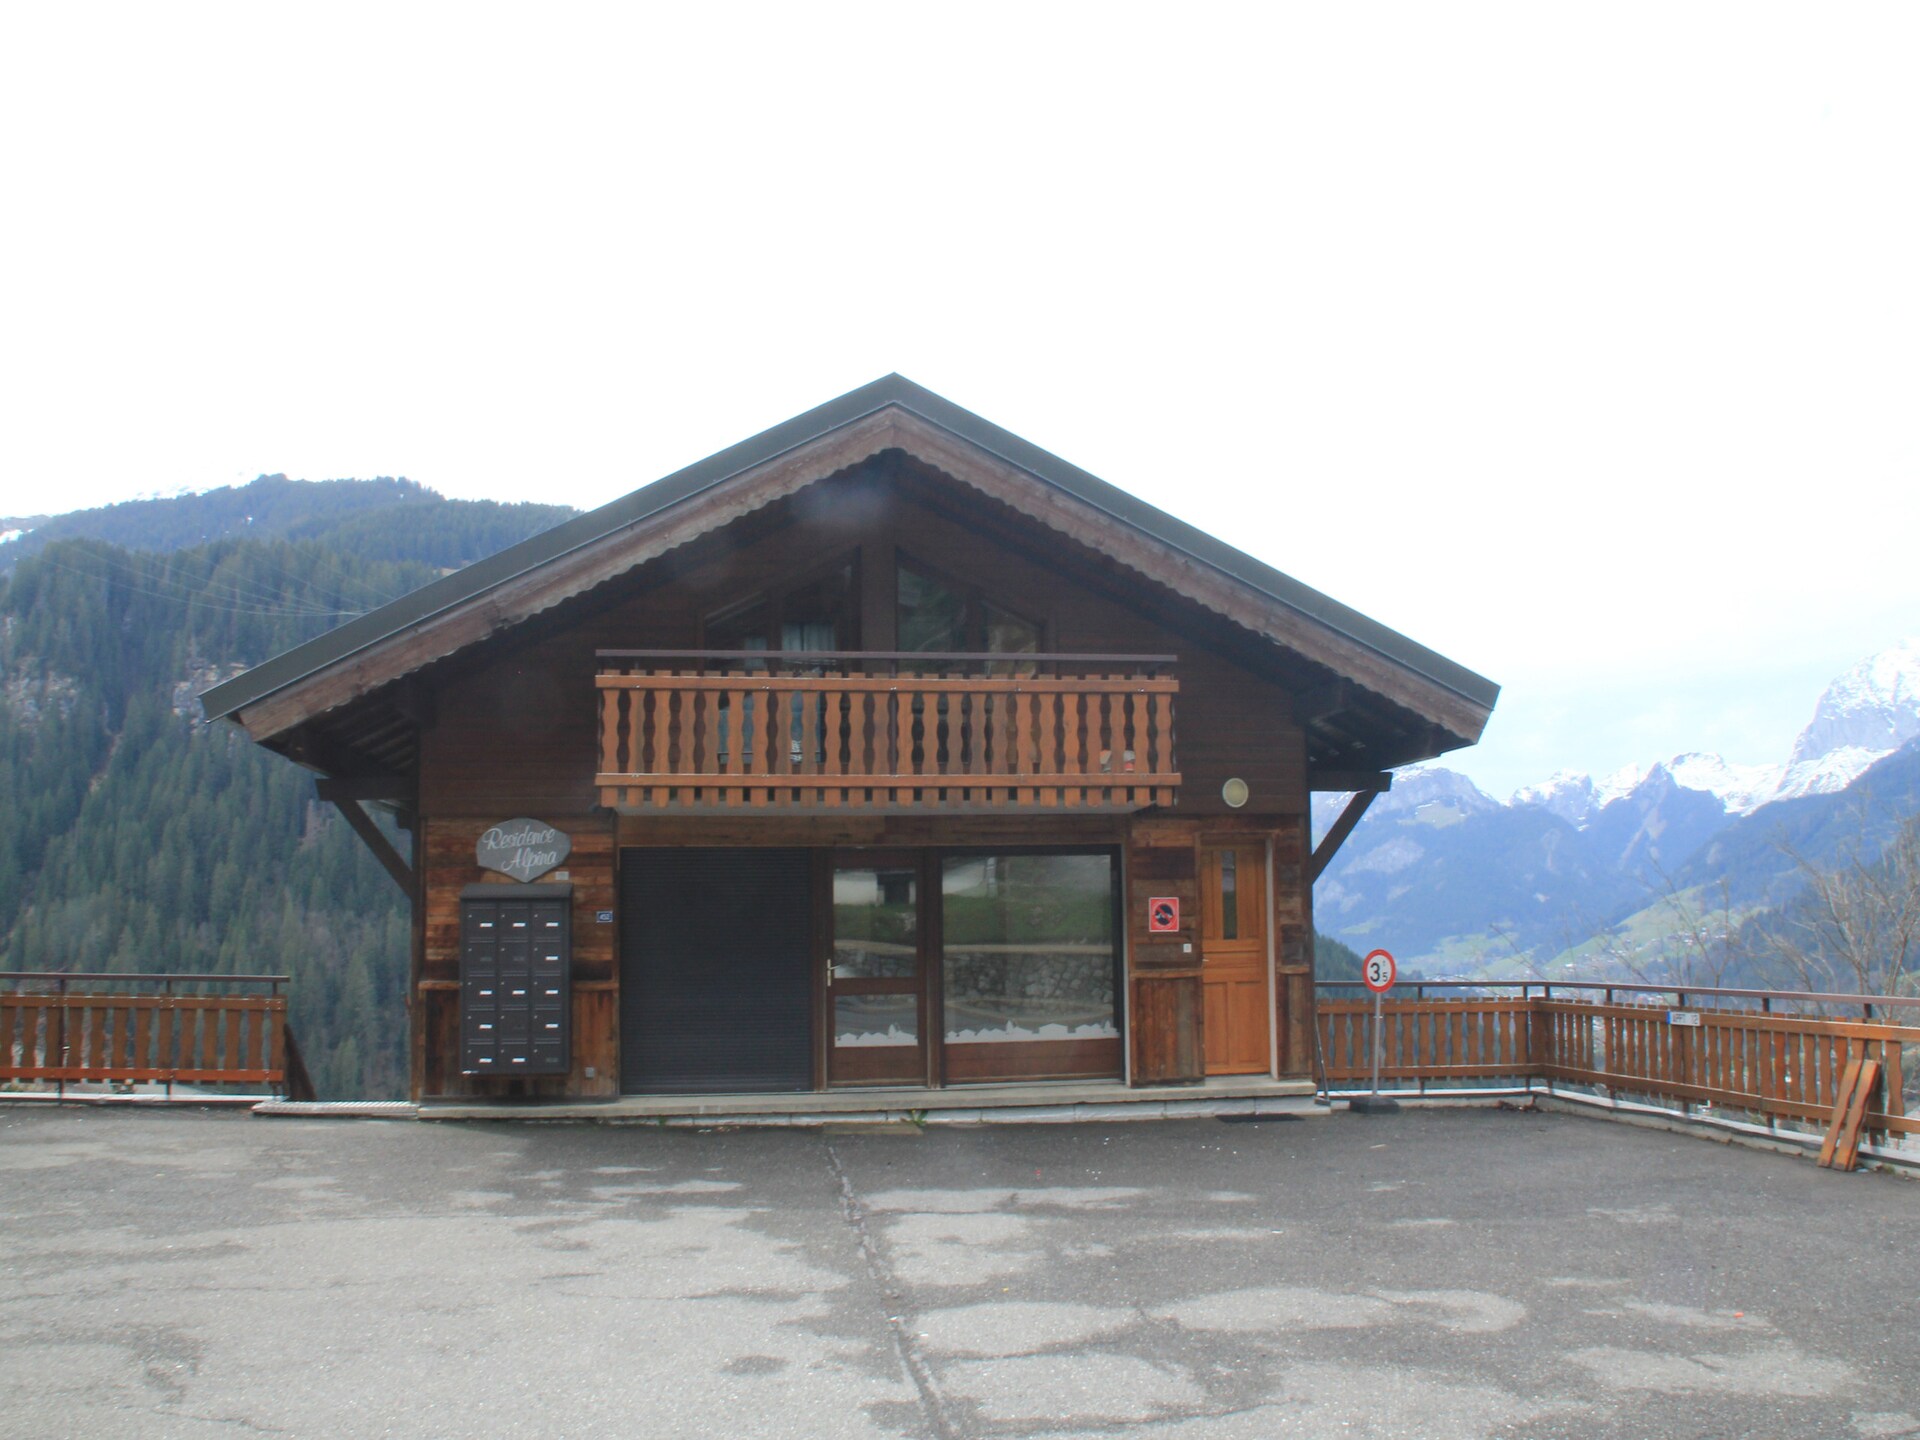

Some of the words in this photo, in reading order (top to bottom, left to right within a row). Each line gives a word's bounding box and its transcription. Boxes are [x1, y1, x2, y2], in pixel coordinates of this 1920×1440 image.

[501, 847, 557, 875] Alpina
[1370, 962, 1380, 982] 3
[1382, 971, 1388, 982] 5
